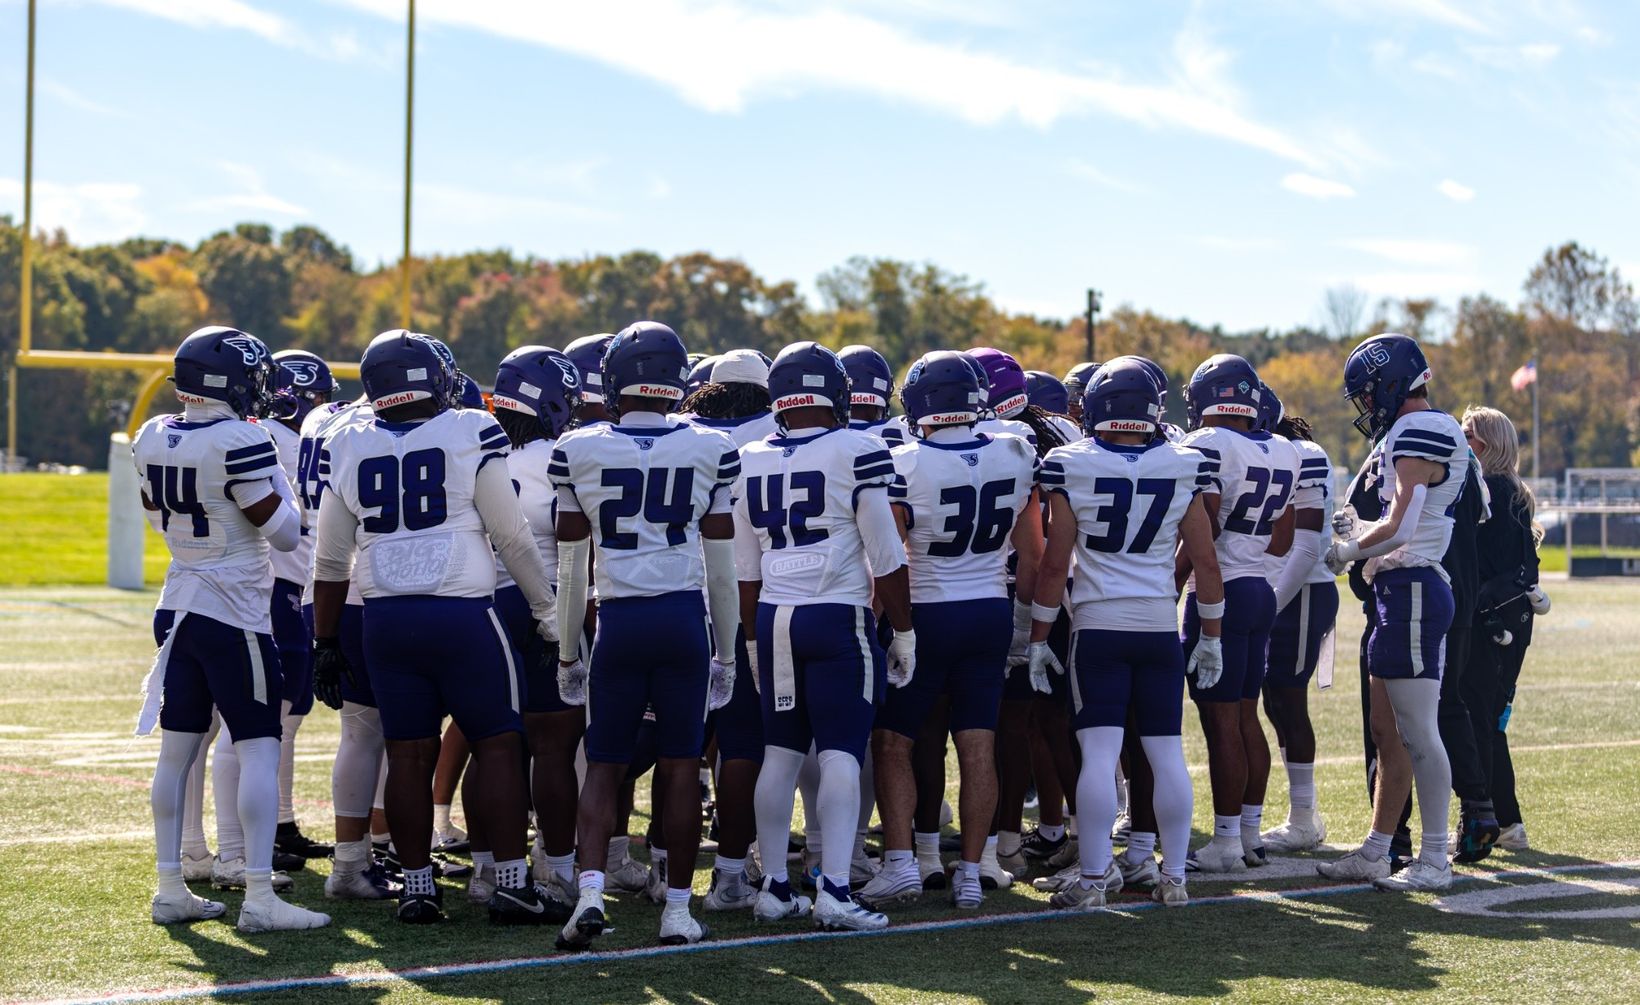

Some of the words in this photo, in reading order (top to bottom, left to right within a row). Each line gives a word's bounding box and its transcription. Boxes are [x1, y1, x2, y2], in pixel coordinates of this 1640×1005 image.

[1360, 342, 1390, 375] 15
[376, 393, 414, 409] Riddell
[639, 385, 680, 398] Riddell
[850, 394, 876, 404] ddell
[776, 395, 815, 410] Riddell
[995, 396, 1026, 415] Riddell
[1217, 405, 1252, 414] Riddell
[932, 414, 970, 423] Riddell
[1110, 422, 1148, 431] Riddell
[358, 447, 447, 534] 98
[147, 464, 210, 537] 14
[599, 467, 695, 550] 24
[747, 470, 829, 550] 42
[1224, 466, 1294, 536] 22
[927, 478, 1016, 557] 36
[1086, 477, 1177, 554] 37
[775, 554, 819, 572] BATTLE
